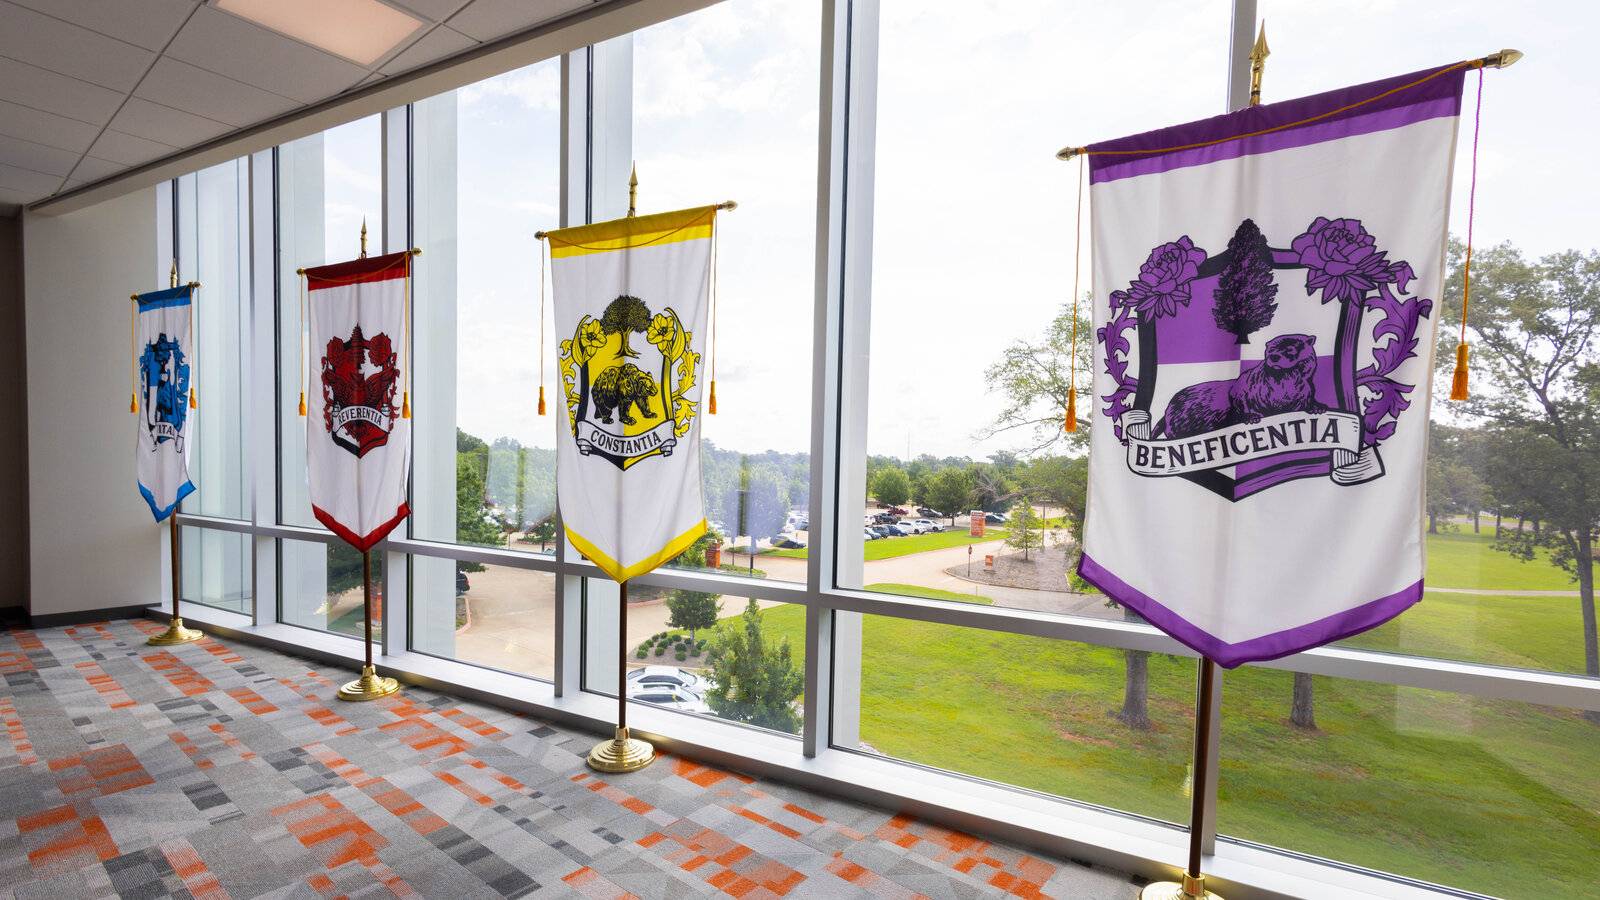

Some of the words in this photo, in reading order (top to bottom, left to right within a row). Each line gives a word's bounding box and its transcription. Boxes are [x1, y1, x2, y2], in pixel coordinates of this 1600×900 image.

[338, 407, 383, 426] REVERENTIA
[590, 429, 661, 454] CONSTANTIA
[1135, 418, 1340, 469] BENEFICENTIA
